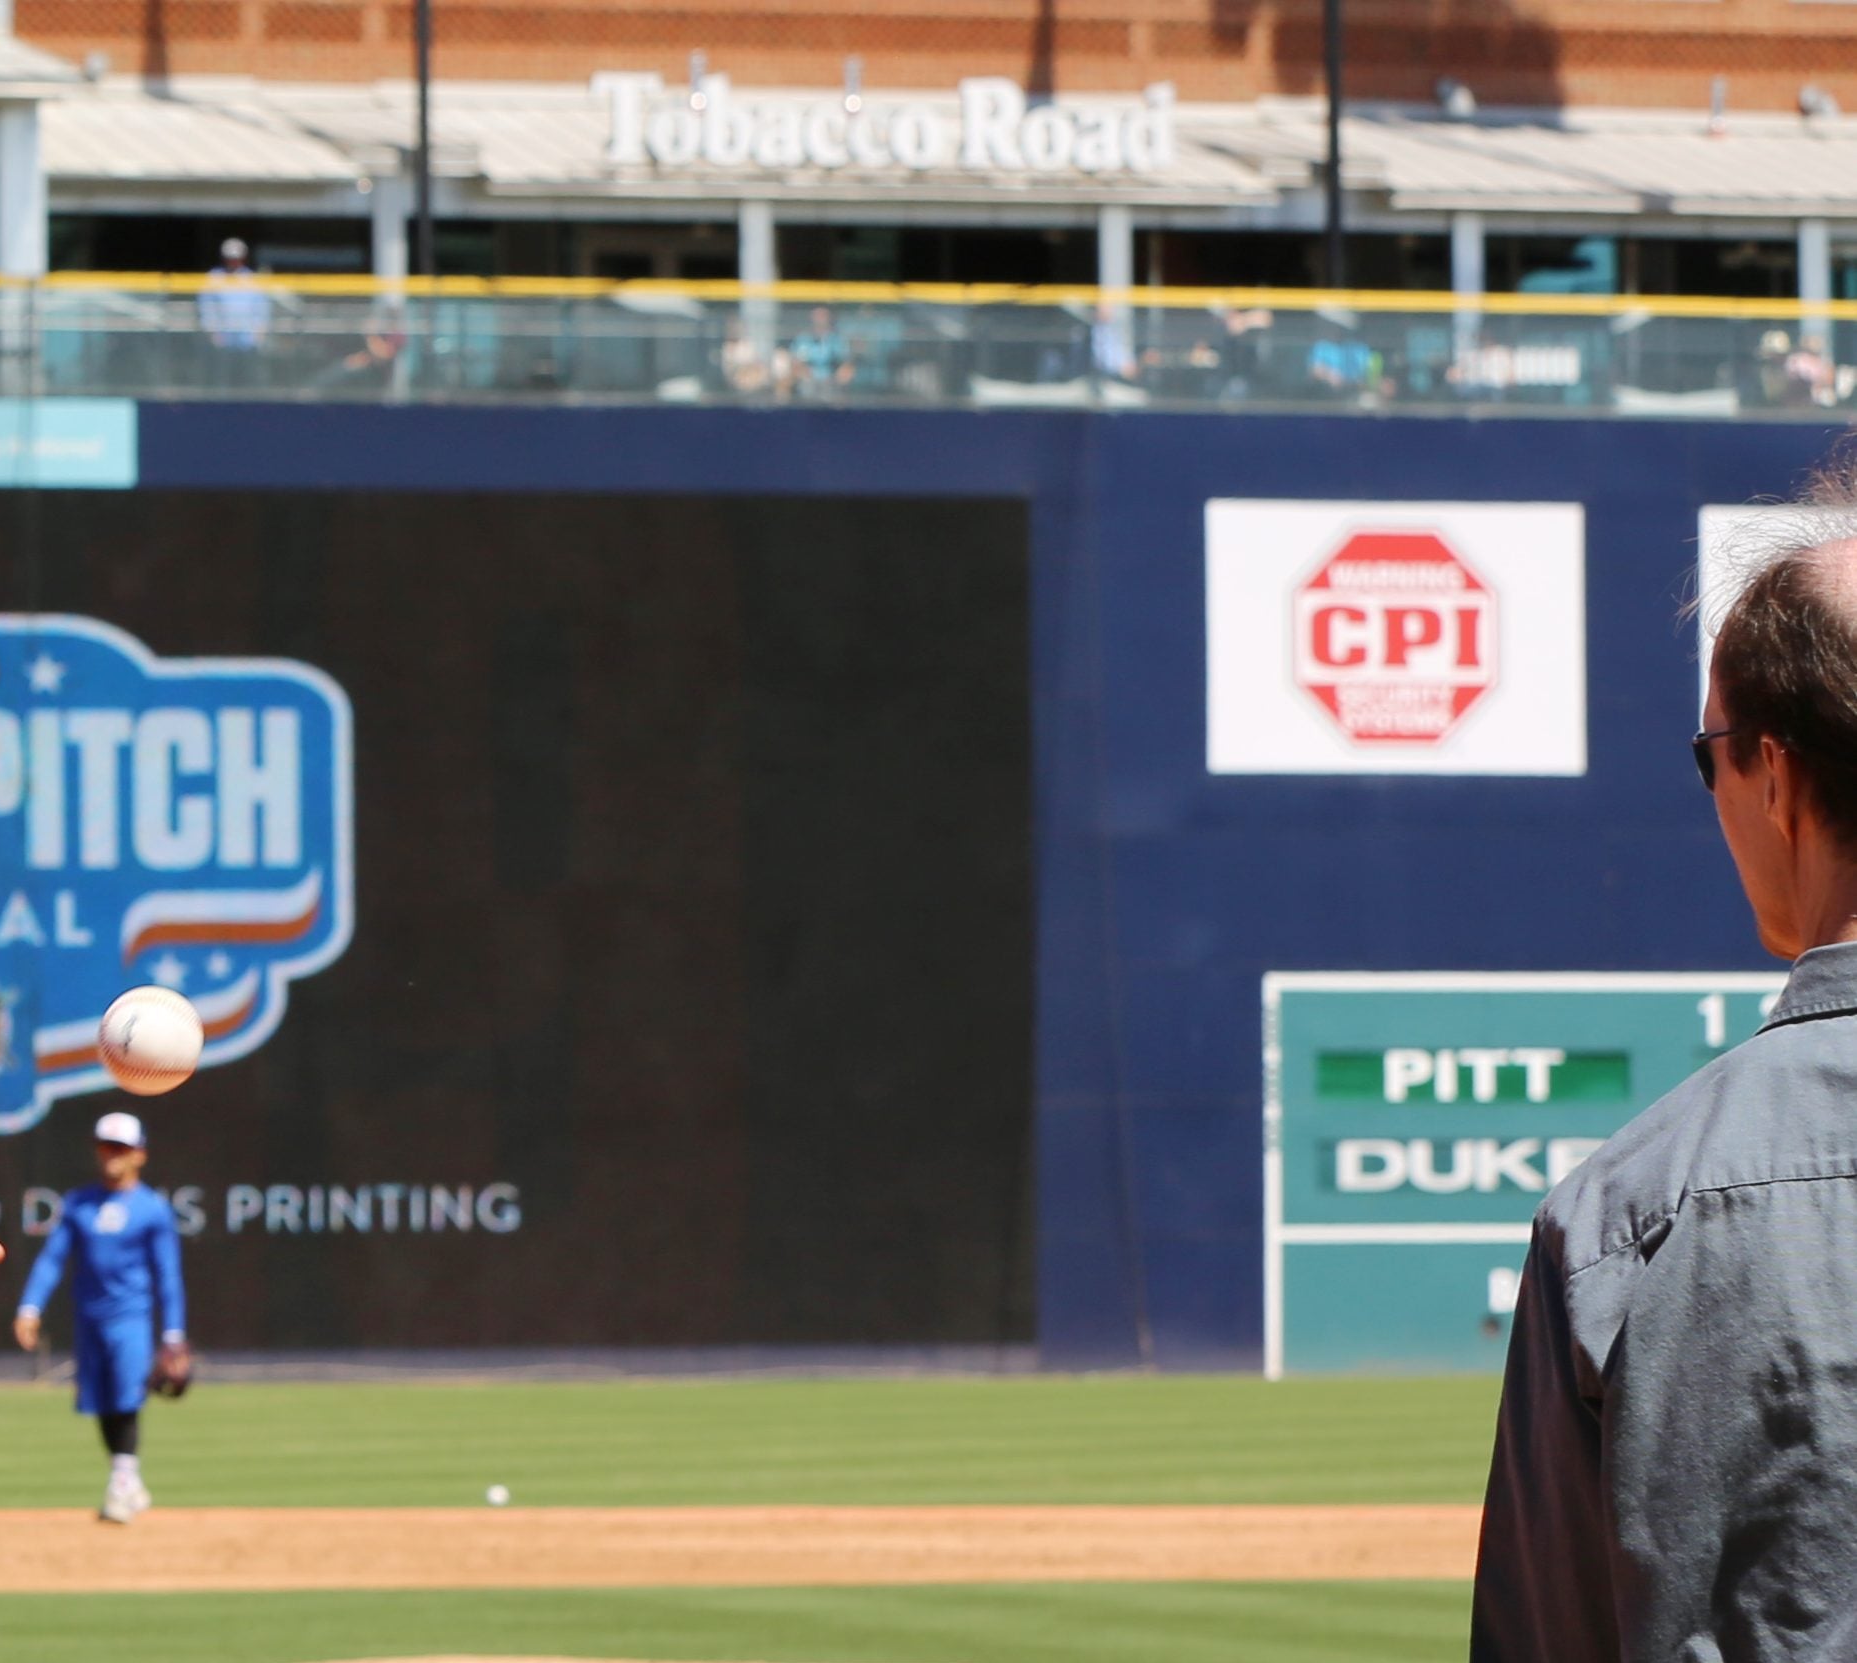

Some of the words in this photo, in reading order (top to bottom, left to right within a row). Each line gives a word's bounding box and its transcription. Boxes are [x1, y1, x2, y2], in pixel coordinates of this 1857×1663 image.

[590, 70, 943, 169] Tobacco
[959, 75, 1176, 173] Road
[1312, 607, 1481, 667] CPI
[1383, 1048, 1566, 1103] PITT
[227, 1183, 522, 1233] PRINTING
